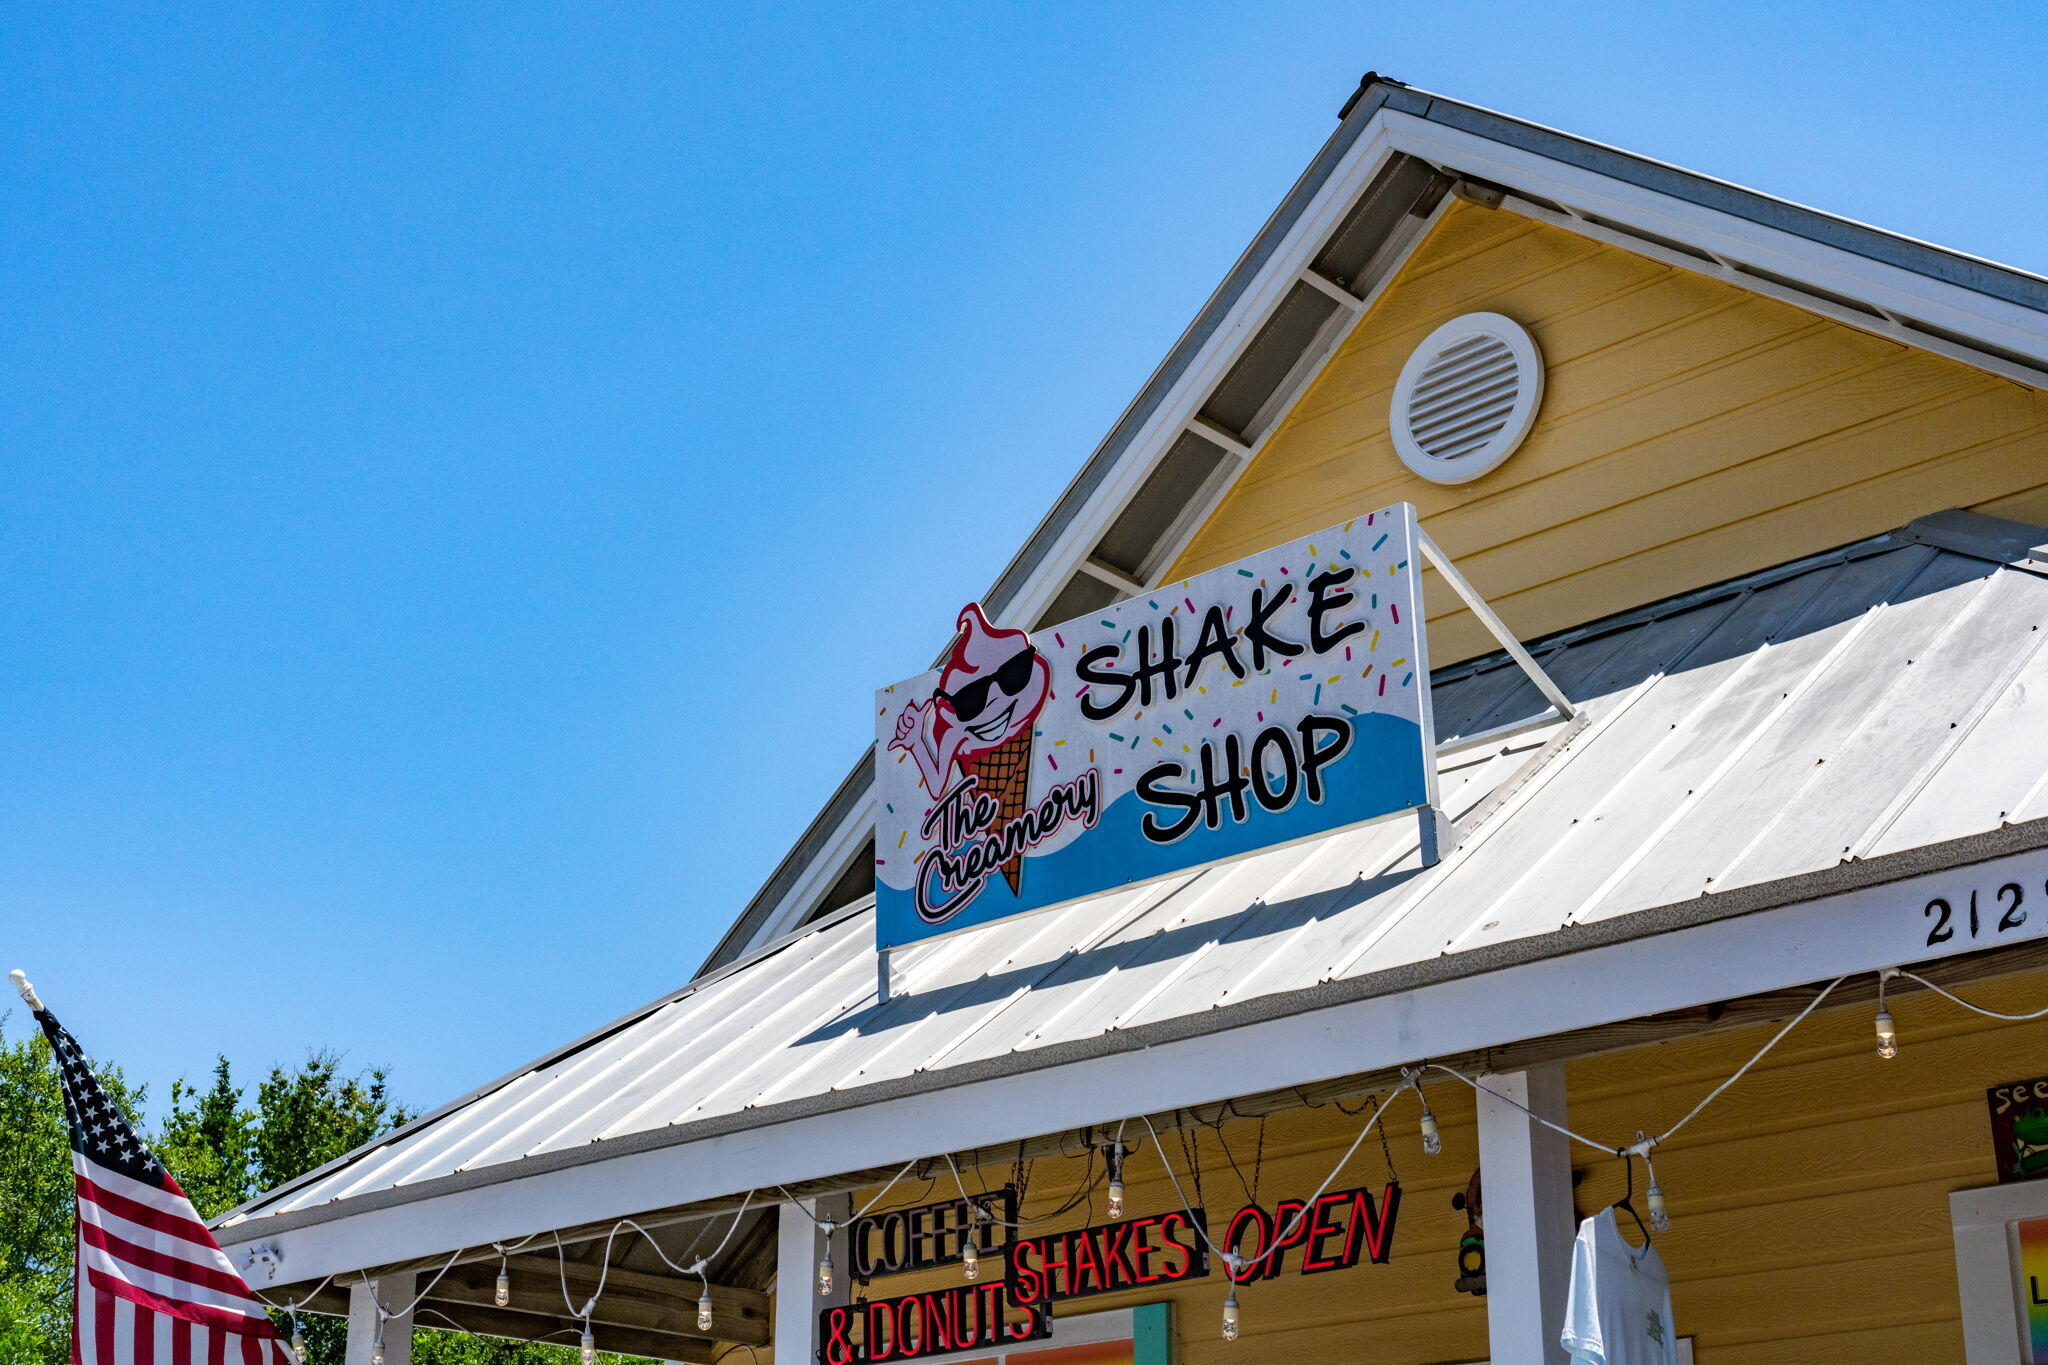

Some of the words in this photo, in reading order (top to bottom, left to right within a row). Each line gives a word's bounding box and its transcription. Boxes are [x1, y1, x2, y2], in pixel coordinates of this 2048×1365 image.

[1074, 565, 1369, 722] SHAKE
[920, 774, 1000, 850] The
[1134, 713, 1355, 845] SHOP
[914, 767, 1101, 924] Creamery
[1924, 879, 2048, 947] 212
[855, 1193, 1001, 1277] COFFEE
[1012, 1212, 1190, 1304] SHAKES
[1222, 1184, 1395, 1282] OPEN
[870, 1277, 1035, 1361] DONUTS
